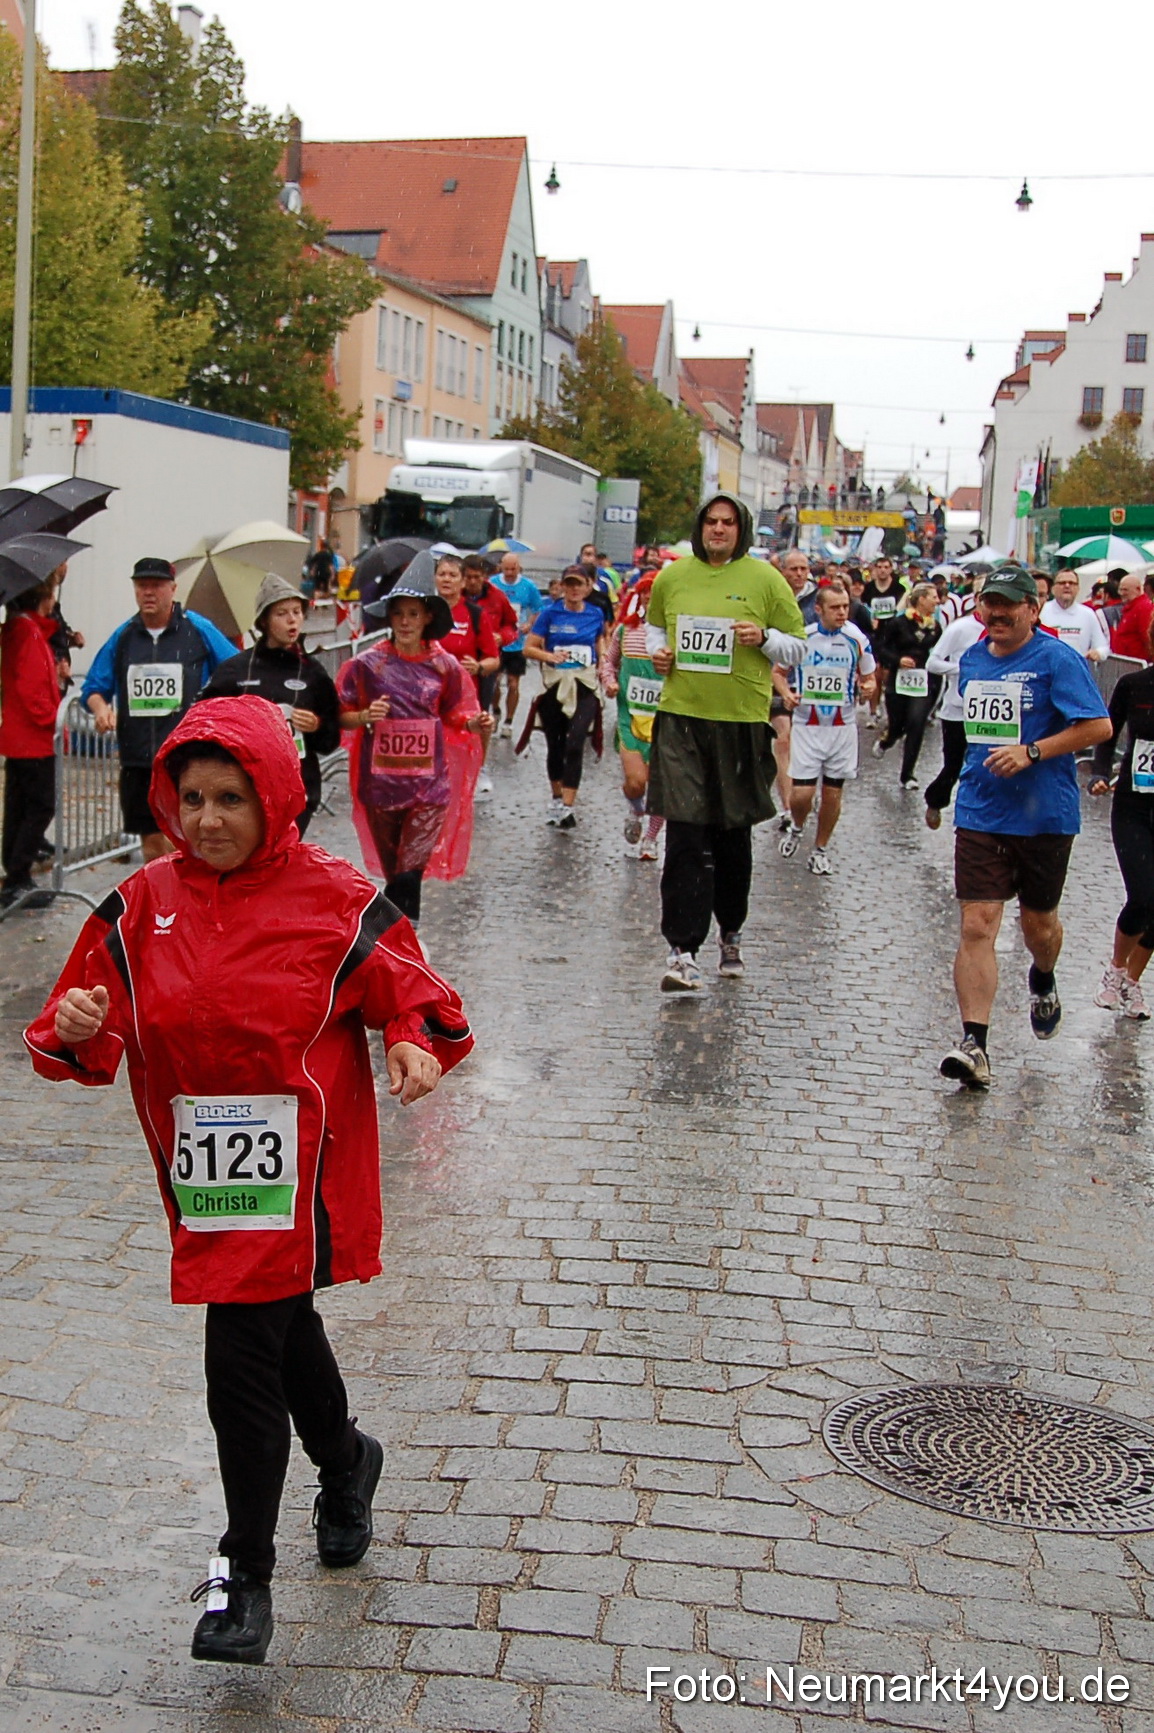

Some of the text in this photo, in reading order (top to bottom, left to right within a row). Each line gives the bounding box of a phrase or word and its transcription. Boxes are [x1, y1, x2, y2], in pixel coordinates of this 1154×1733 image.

[681, 630, 727, 653] 5074
[133, 678, 176, 697] 5028
[630, 686, 661, 704] 5104
[807, 676, 842, 692] 5126
[967, 697, 1014, 722] 5163
[379, 733, 429, 755] 5029
[194, 1104, 252, 1119] BOCK
[176, 1130, 283, 1181] 5123
[192, 1191, 258, 1213] Christa
